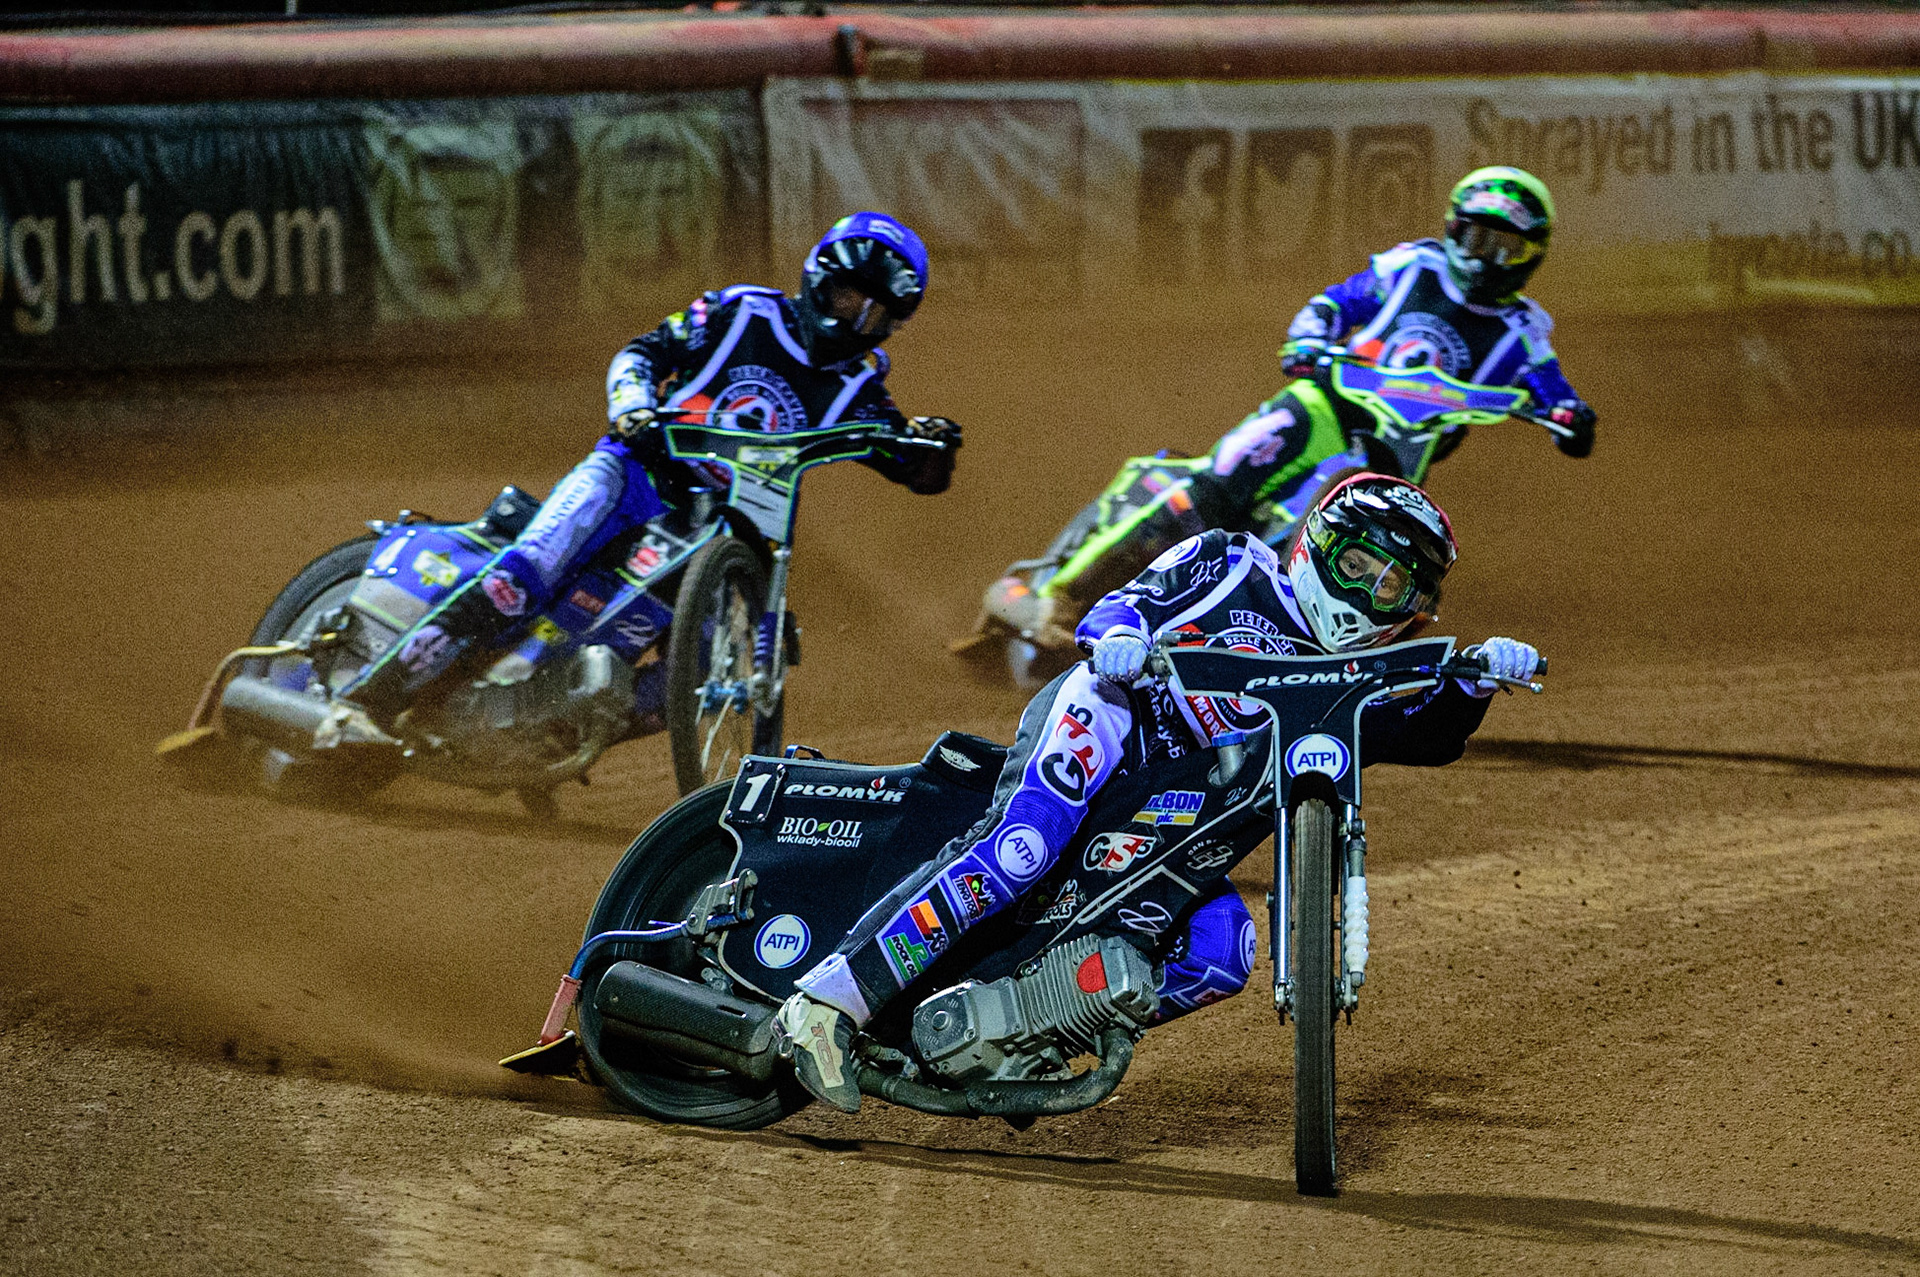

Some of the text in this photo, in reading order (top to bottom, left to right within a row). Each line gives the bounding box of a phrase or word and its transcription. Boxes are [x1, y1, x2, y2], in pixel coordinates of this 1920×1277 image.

[1694, 106, 1734, 173] in
[1752, 94, 1835, 172] the
[0, 178, 345, 335] ght.com
[1229, 610, 1278, 635] PETER
[1297, 751, 1337, 767] ATPI
[739, 773, 772, 812] 1
[778, 816, 864, 838] BIO OIL
[1008, 835, 1037, 870] ATPI
[764, 932, 800, 951] ATPI
[891, 935, 910, 964] ROCK
